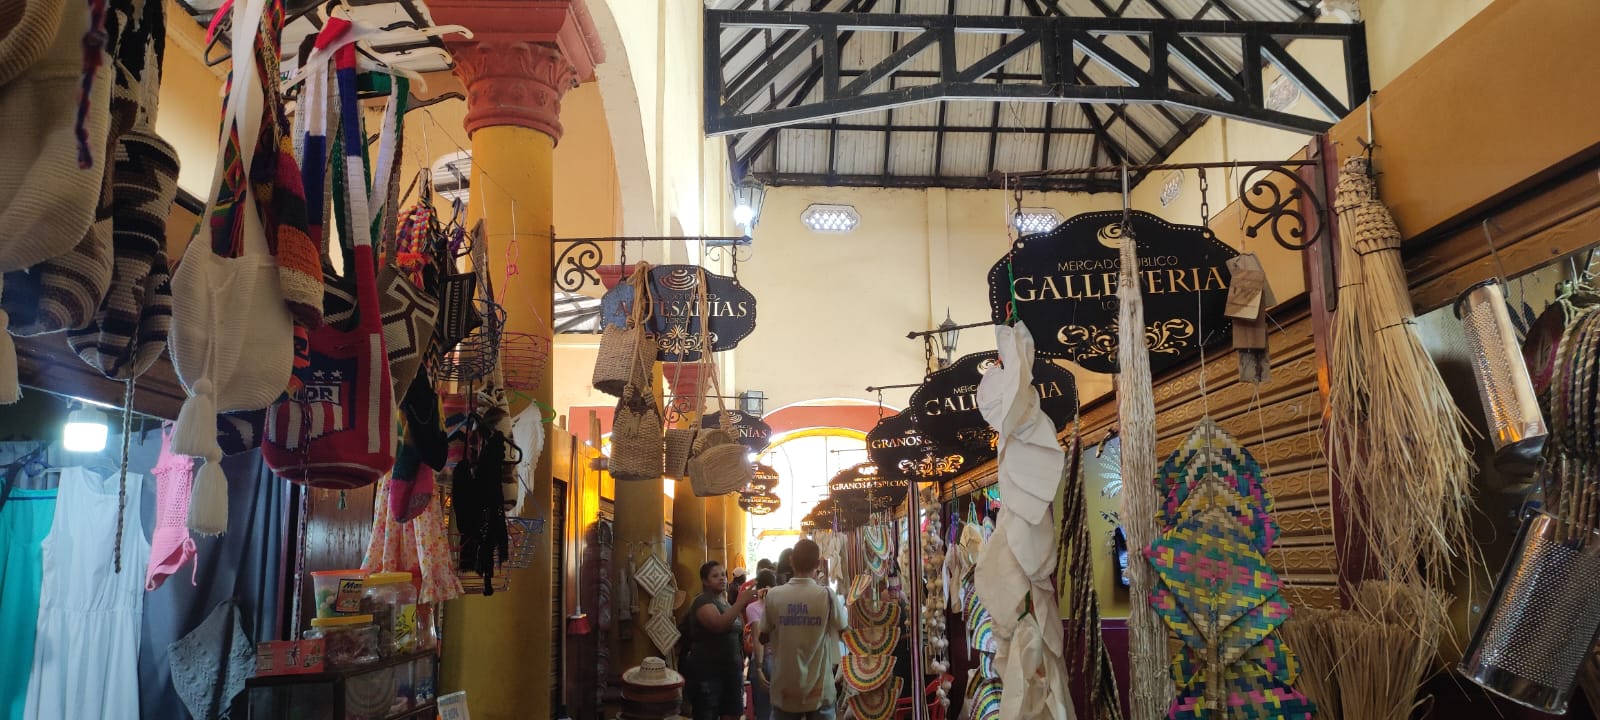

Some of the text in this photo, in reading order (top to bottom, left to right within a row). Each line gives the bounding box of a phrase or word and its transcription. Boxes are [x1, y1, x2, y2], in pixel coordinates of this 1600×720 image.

[1012, 266, 1230, 302] GALLEERIA
[615, 297, 747, 319] AESANÍAS
[953, 384, 977, 395] MERC
[871, 435, 922, 449] GRANOS
[832, 482, 865, 491] GRANOS
